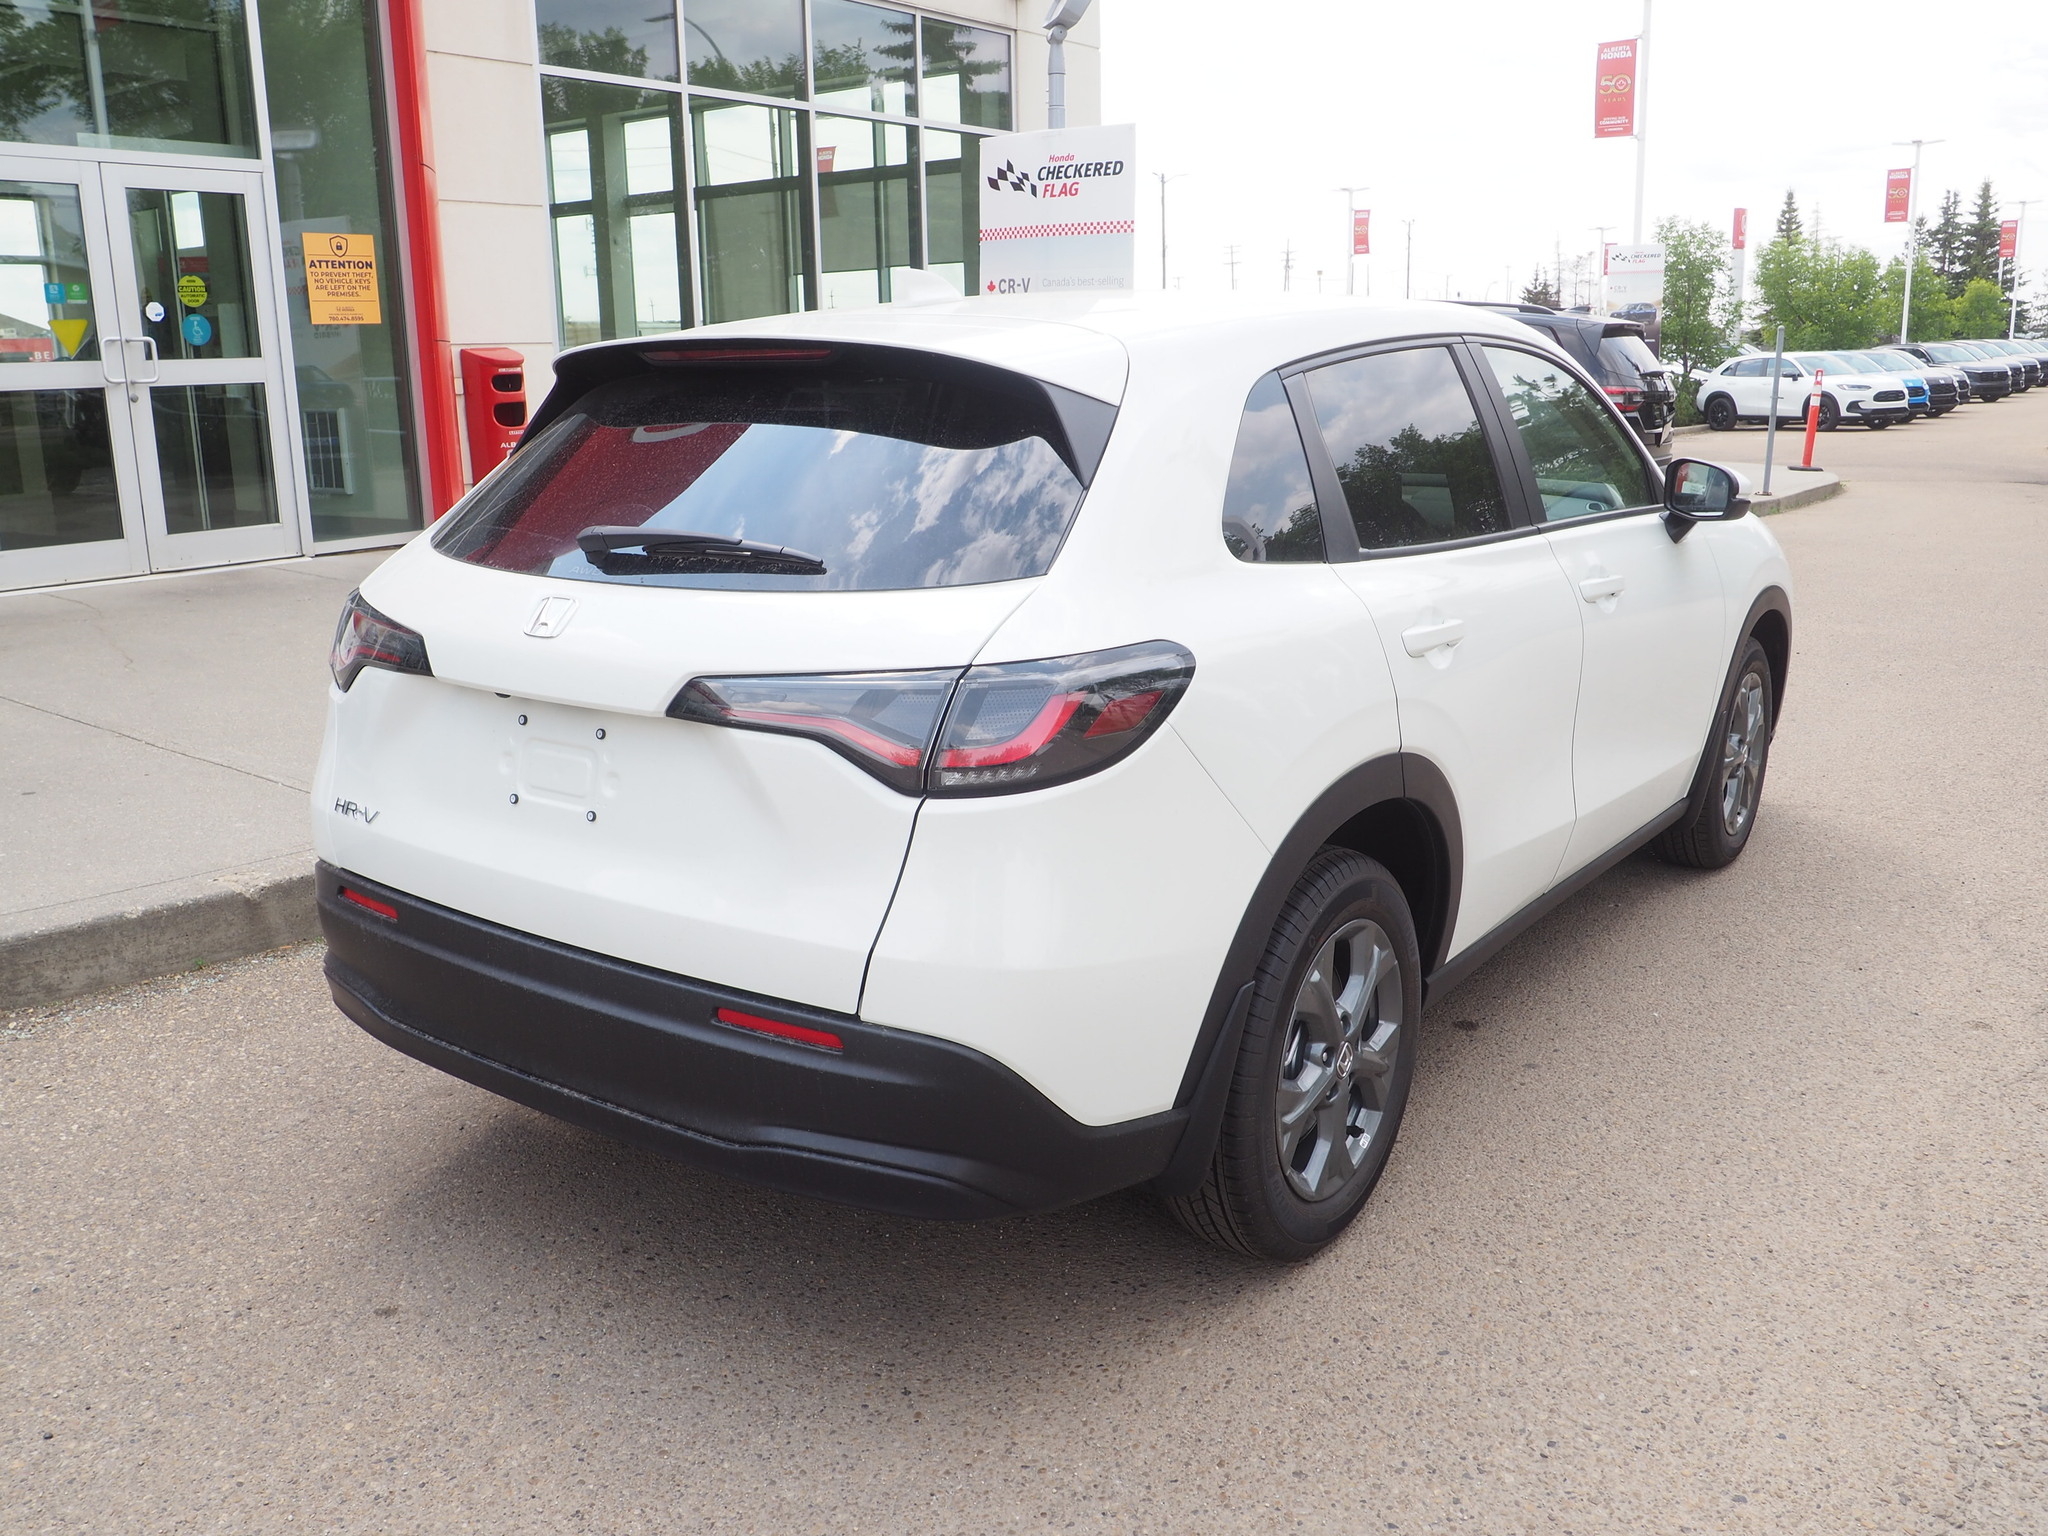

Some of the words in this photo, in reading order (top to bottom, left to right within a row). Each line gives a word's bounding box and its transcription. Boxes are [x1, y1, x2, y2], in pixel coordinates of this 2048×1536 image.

[1600, 50, 1632, 60] HONDA
[1599, 73, 1632, 95] 50
[1048, 153, 1075, 163] Honda
[1037, 160, 1124, 181] CHECKERED
[1042, 181, 1080, 198] FLAG
[1888, 187, 1908, 199] 50
[309, 260, 373, 270] ATTENTION
[352, 271, 374, 279] THEFT,
[998, 277, 1031, 294] CR-V
[1042, 276, 1076, 288] Canada's
[1077, 275, 1124, 287] best-selling
[334, 797, 381, 825] HR-V
